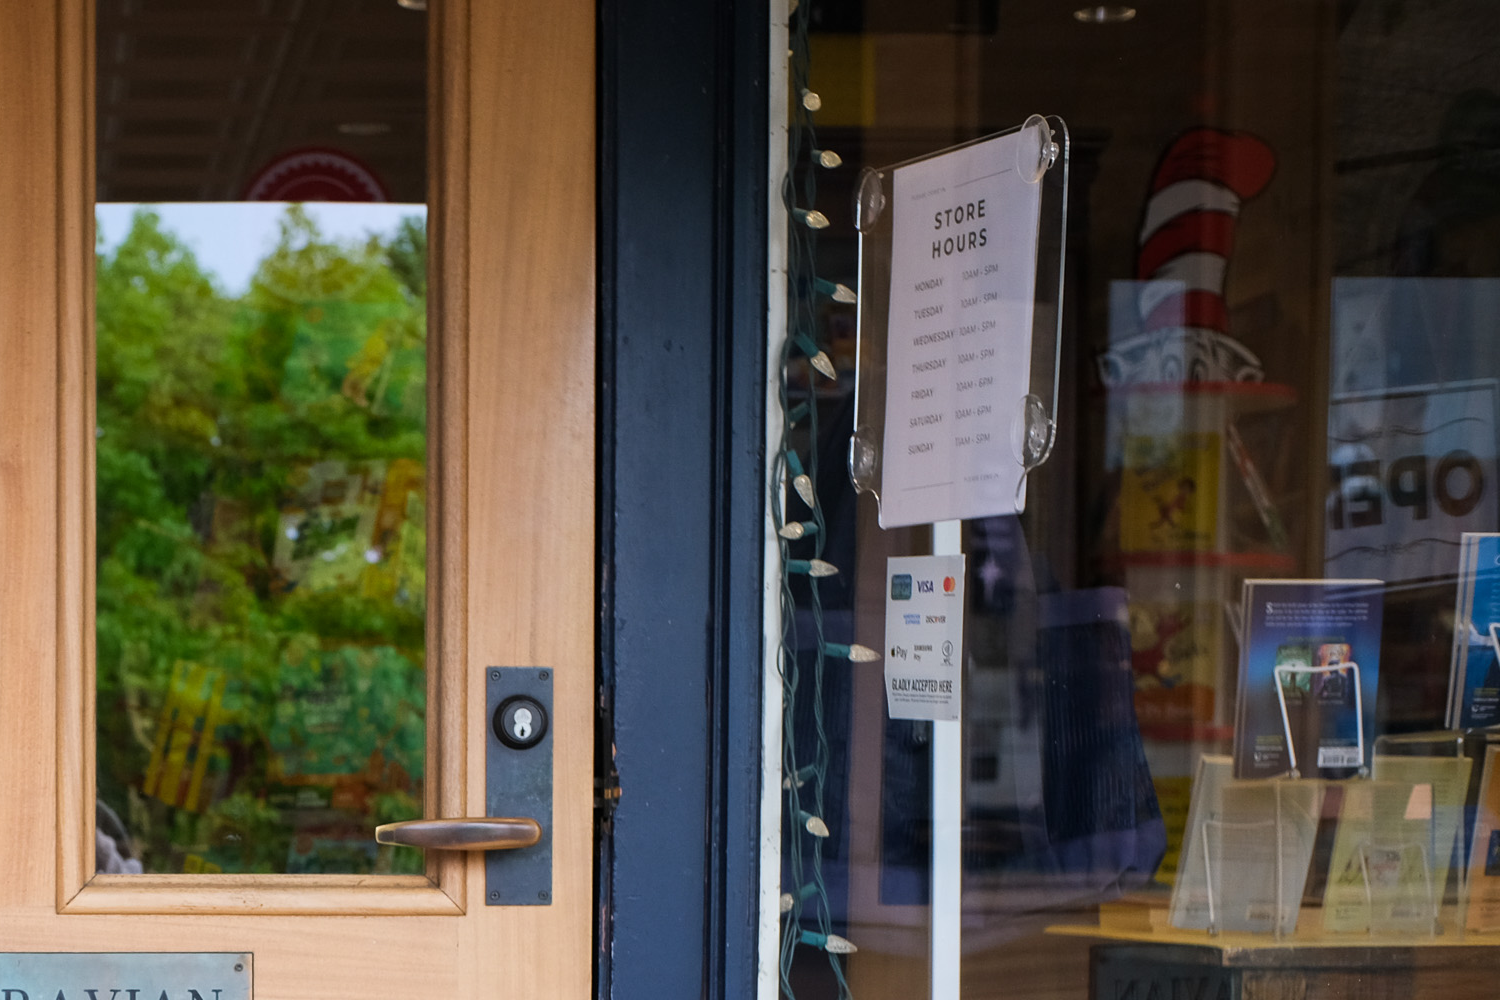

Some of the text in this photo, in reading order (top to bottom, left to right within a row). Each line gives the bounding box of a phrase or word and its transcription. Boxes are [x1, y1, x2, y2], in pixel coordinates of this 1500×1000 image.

[934, 199, 986, 230] STORE
[932, 228, 987, 259] HOURS
[914, 277, 944, 292] MONDAY
[914, 305, 944, 320] TUESDAY
[913, 330, 954, 347] WEDNESDAY
[912, 357, 947, 374] THURSDAY
[911, 388, 934, 400] FRIDAY
[909, 413, 943, 428] SATURDAY
[908, 442, 935, 455] SUNDAY
[917, 580, 934, 593] VISA
[896, 646, 908, 661] Pay
[892, 677, 953, 694] GLADLY ACCEPTED HERE
